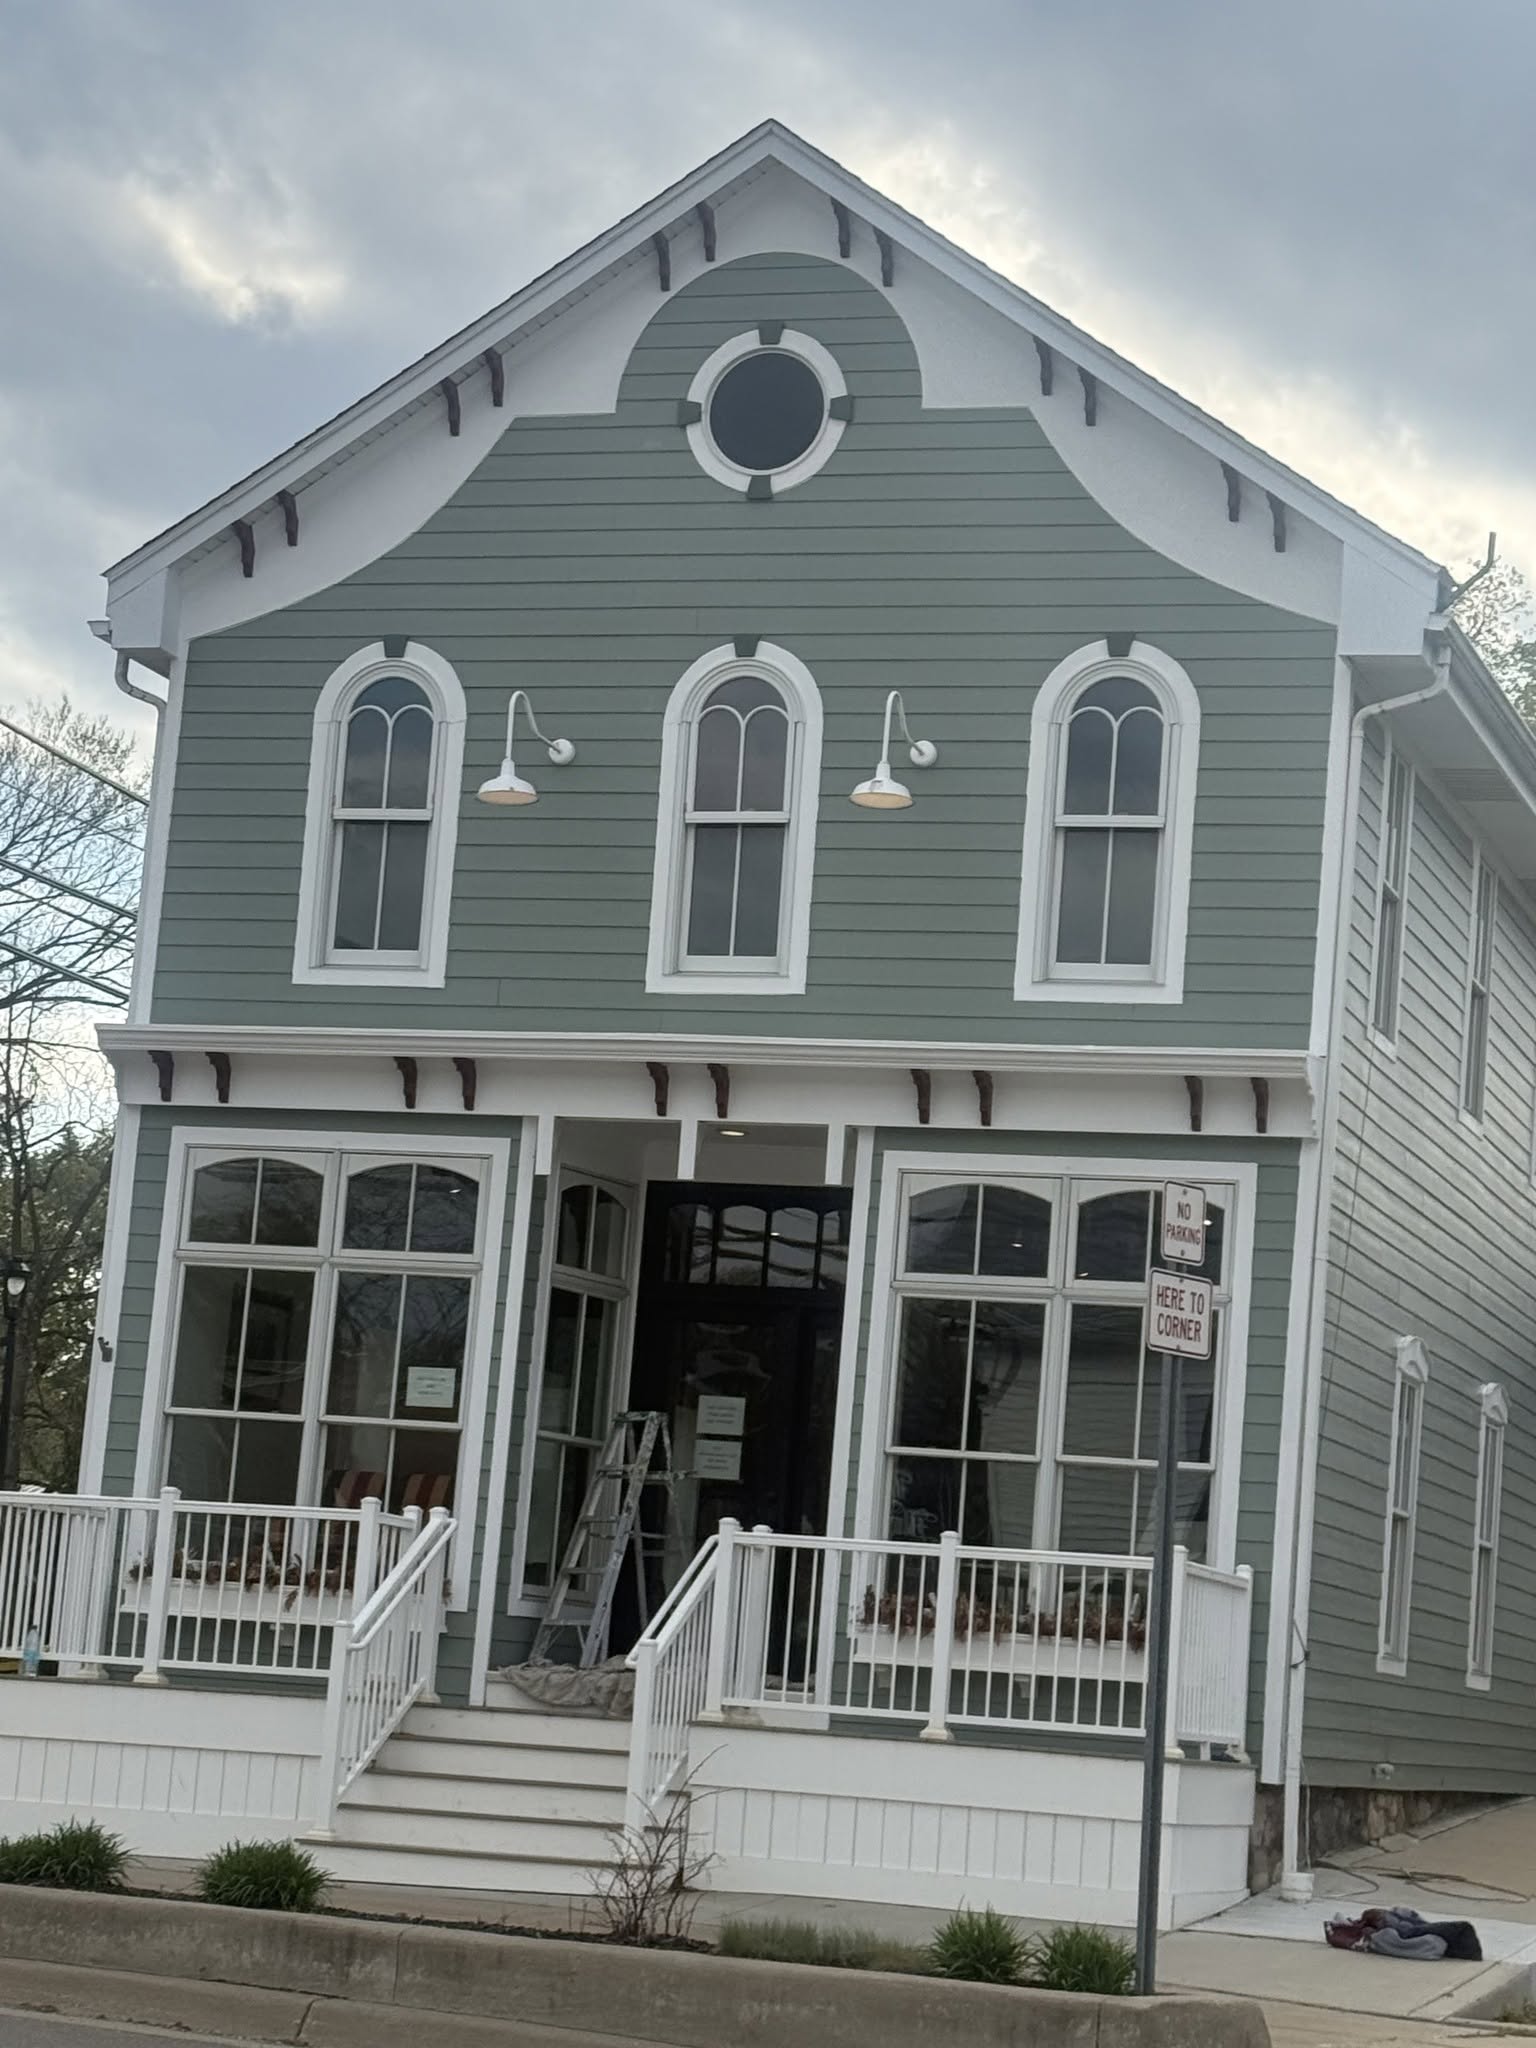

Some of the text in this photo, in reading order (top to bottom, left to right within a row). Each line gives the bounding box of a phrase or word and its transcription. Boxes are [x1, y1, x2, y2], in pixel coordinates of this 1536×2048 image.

[1177, 1201, 1191, 1221] NO
[1166, 1223, 1201, 1246] PARKING
[1156, 1284, 1205, 1315] HERE TO
[1157, 1313, 1202, 1342] CORNER
